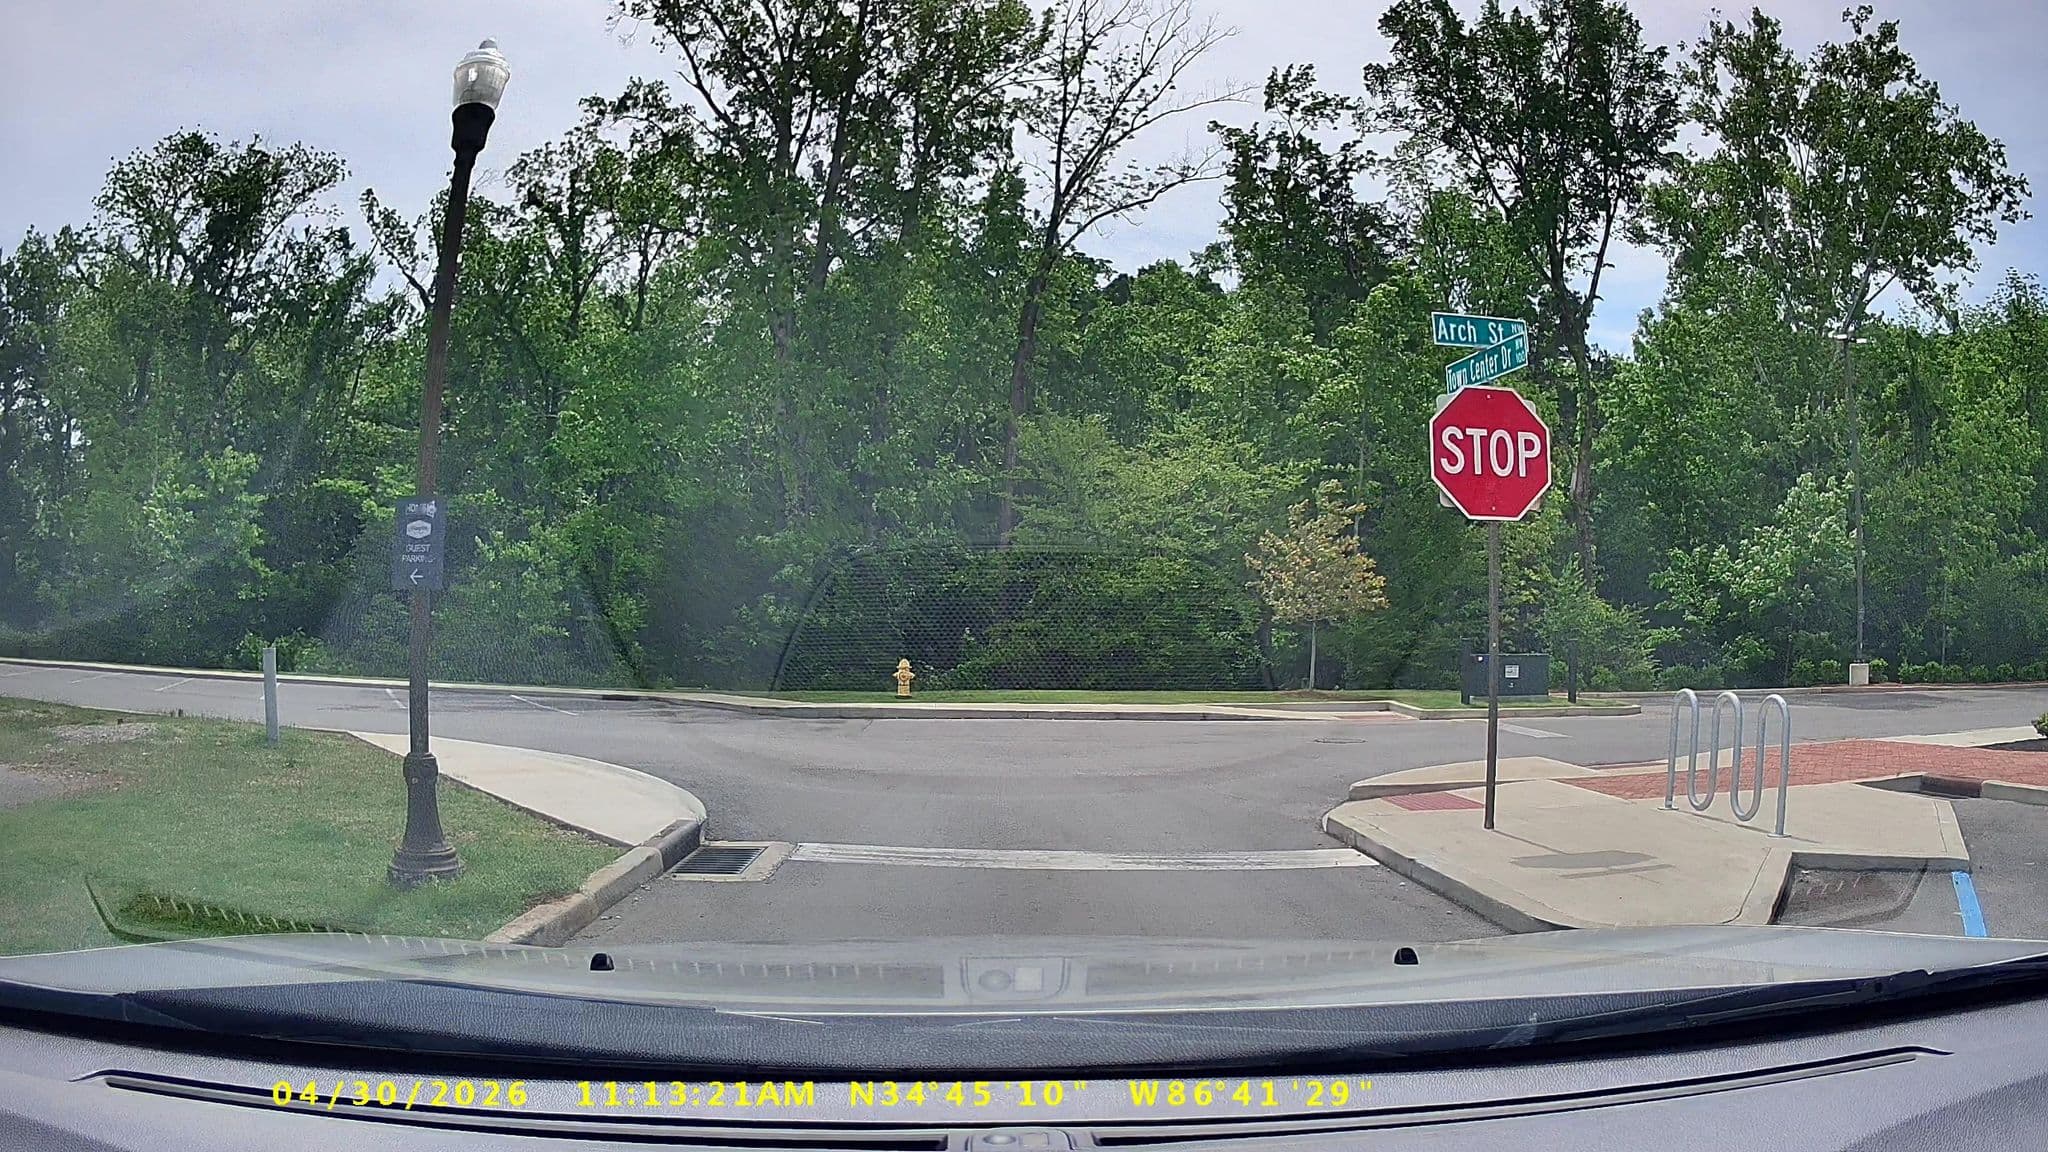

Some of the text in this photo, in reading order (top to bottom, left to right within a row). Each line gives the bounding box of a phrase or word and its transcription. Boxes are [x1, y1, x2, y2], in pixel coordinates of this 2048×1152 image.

[1438, 317, 1477, 342] Arch
[1488, 322, 1503, 344] St
[1447, 368, 1468, 391] Town
[1470, 353, 1499, 380] Center
[1501, 345, 1511, 369] Dr
[1440, 426, 1541, 477] STOP
[402, 554, 436, 563] PARKIG
[405, 543, 432, 553] GUEST
